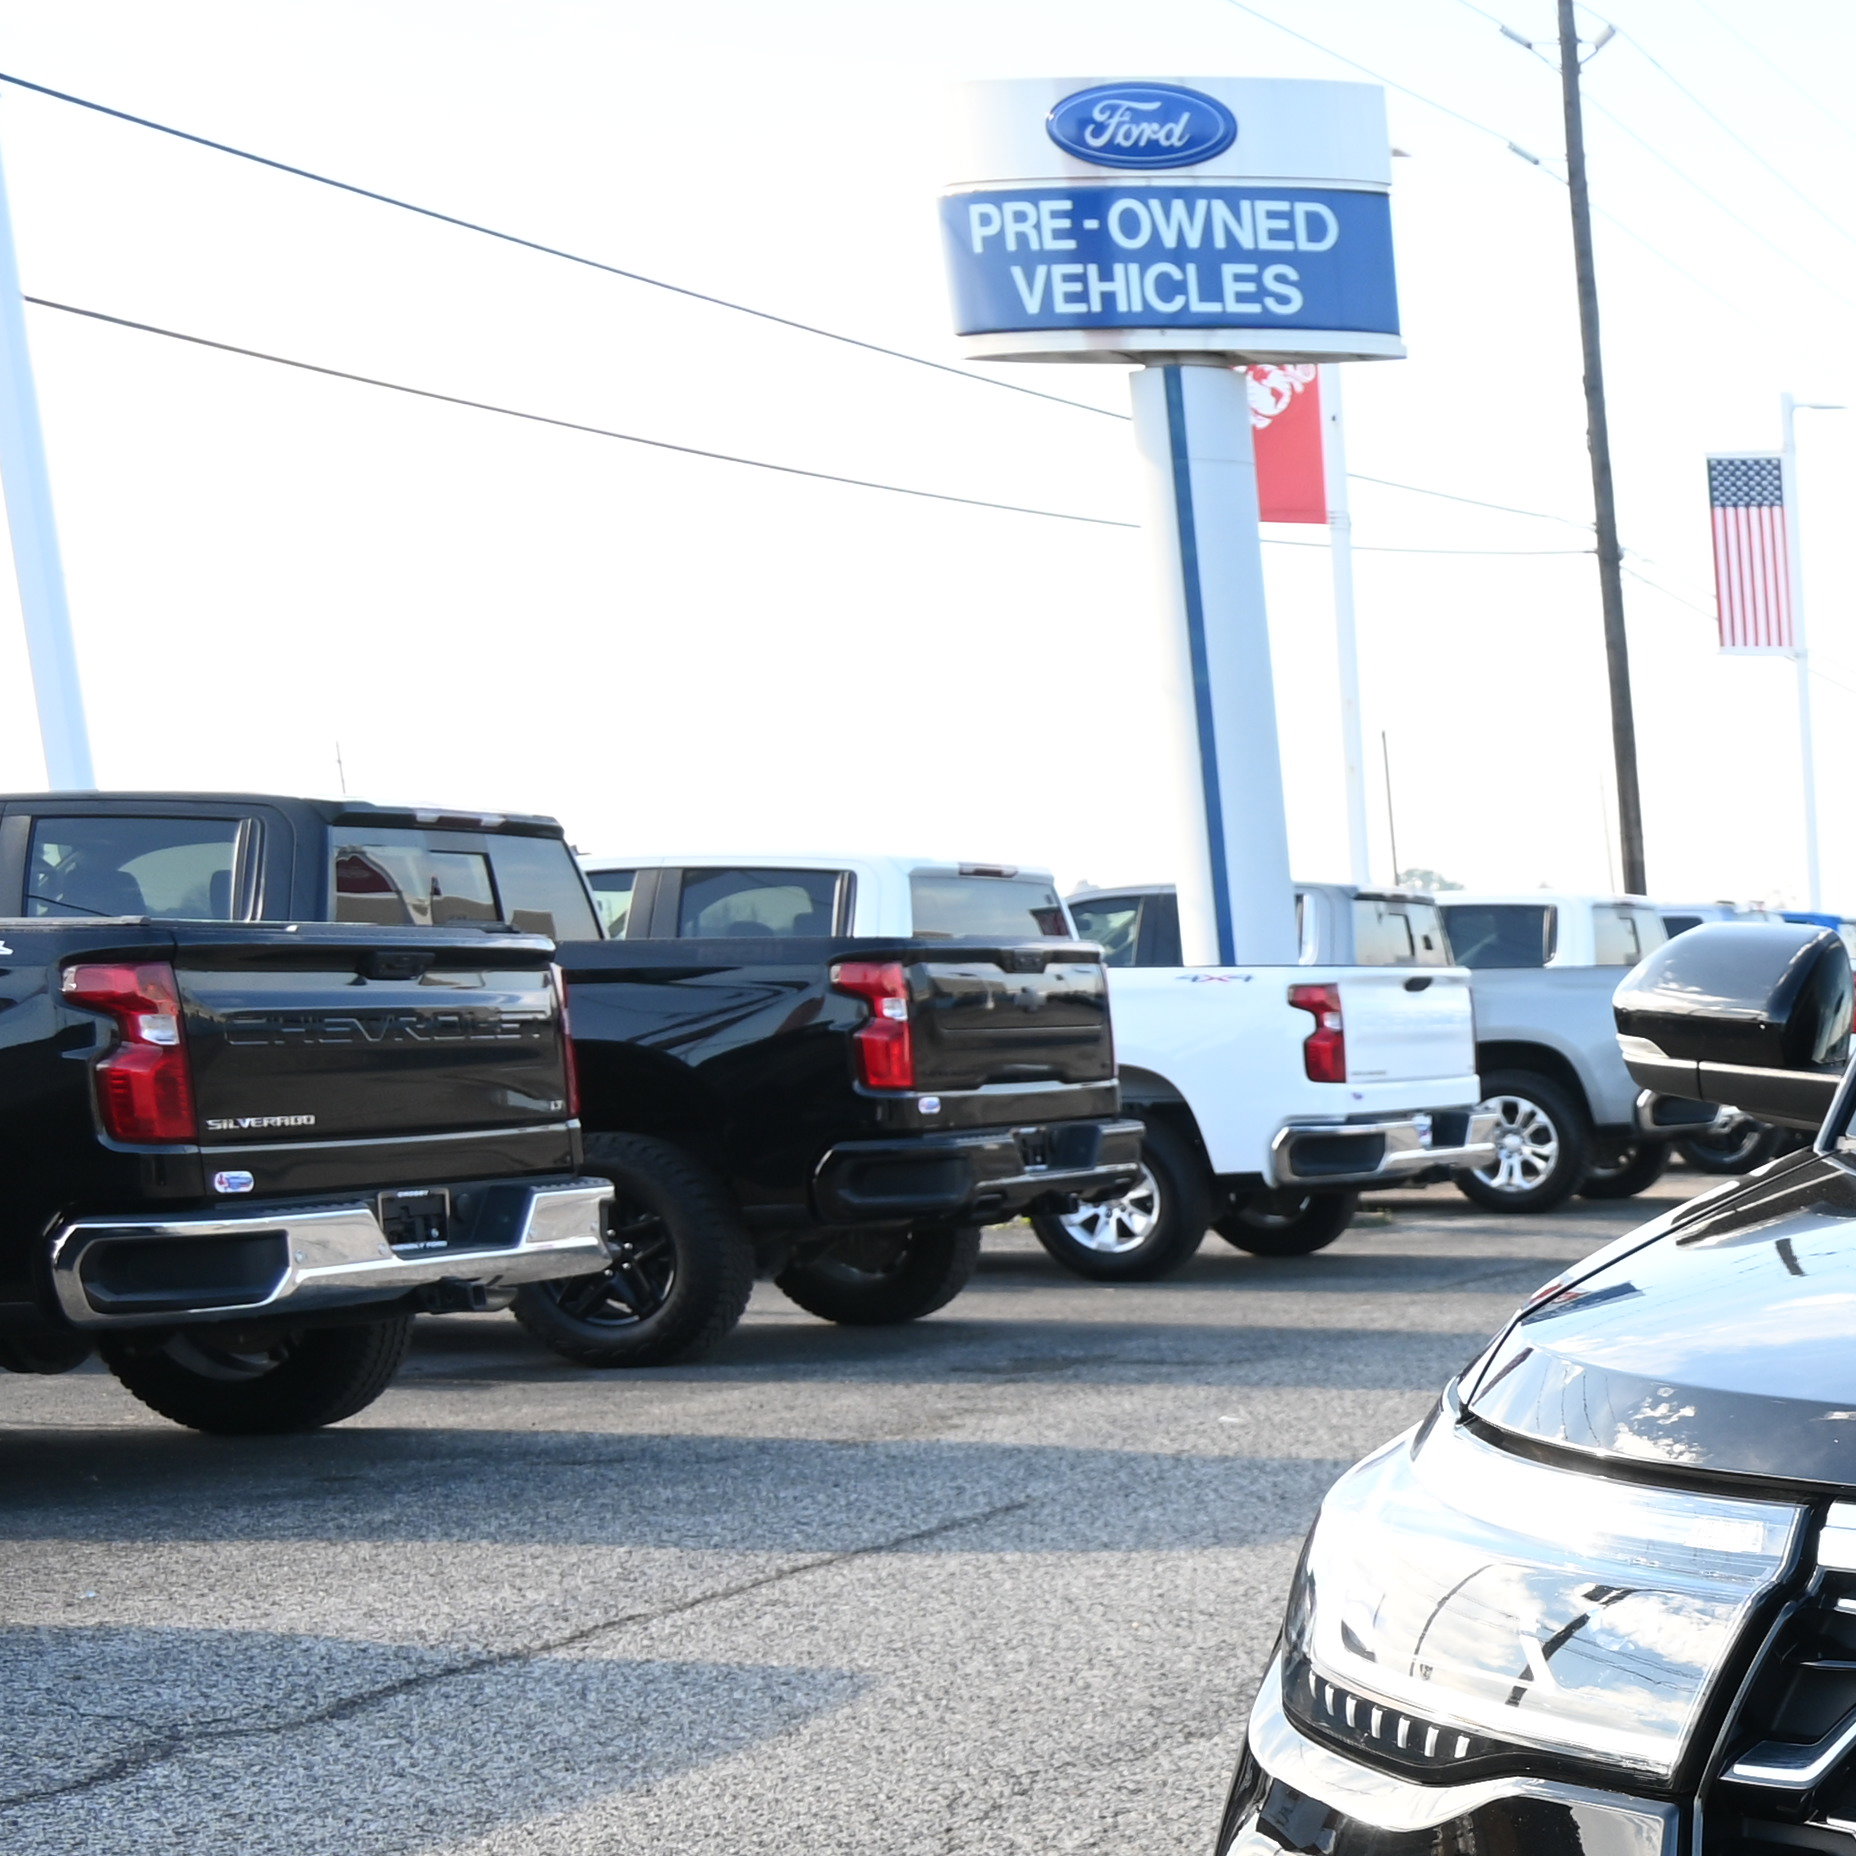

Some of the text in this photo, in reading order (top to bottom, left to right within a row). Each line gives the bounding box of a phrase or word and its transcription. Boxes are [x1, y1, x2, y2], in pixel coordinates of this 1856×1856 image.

[1083, 99, 1191, 148] Ford
[969, 198, 1340, 254] PRE-OWNED
[1010, 262, 1304, 315] VEHICLES
[225, 1010, 551, 1046] CHEVROLET
[206, 1114, 316, 1131] SILVERADO
